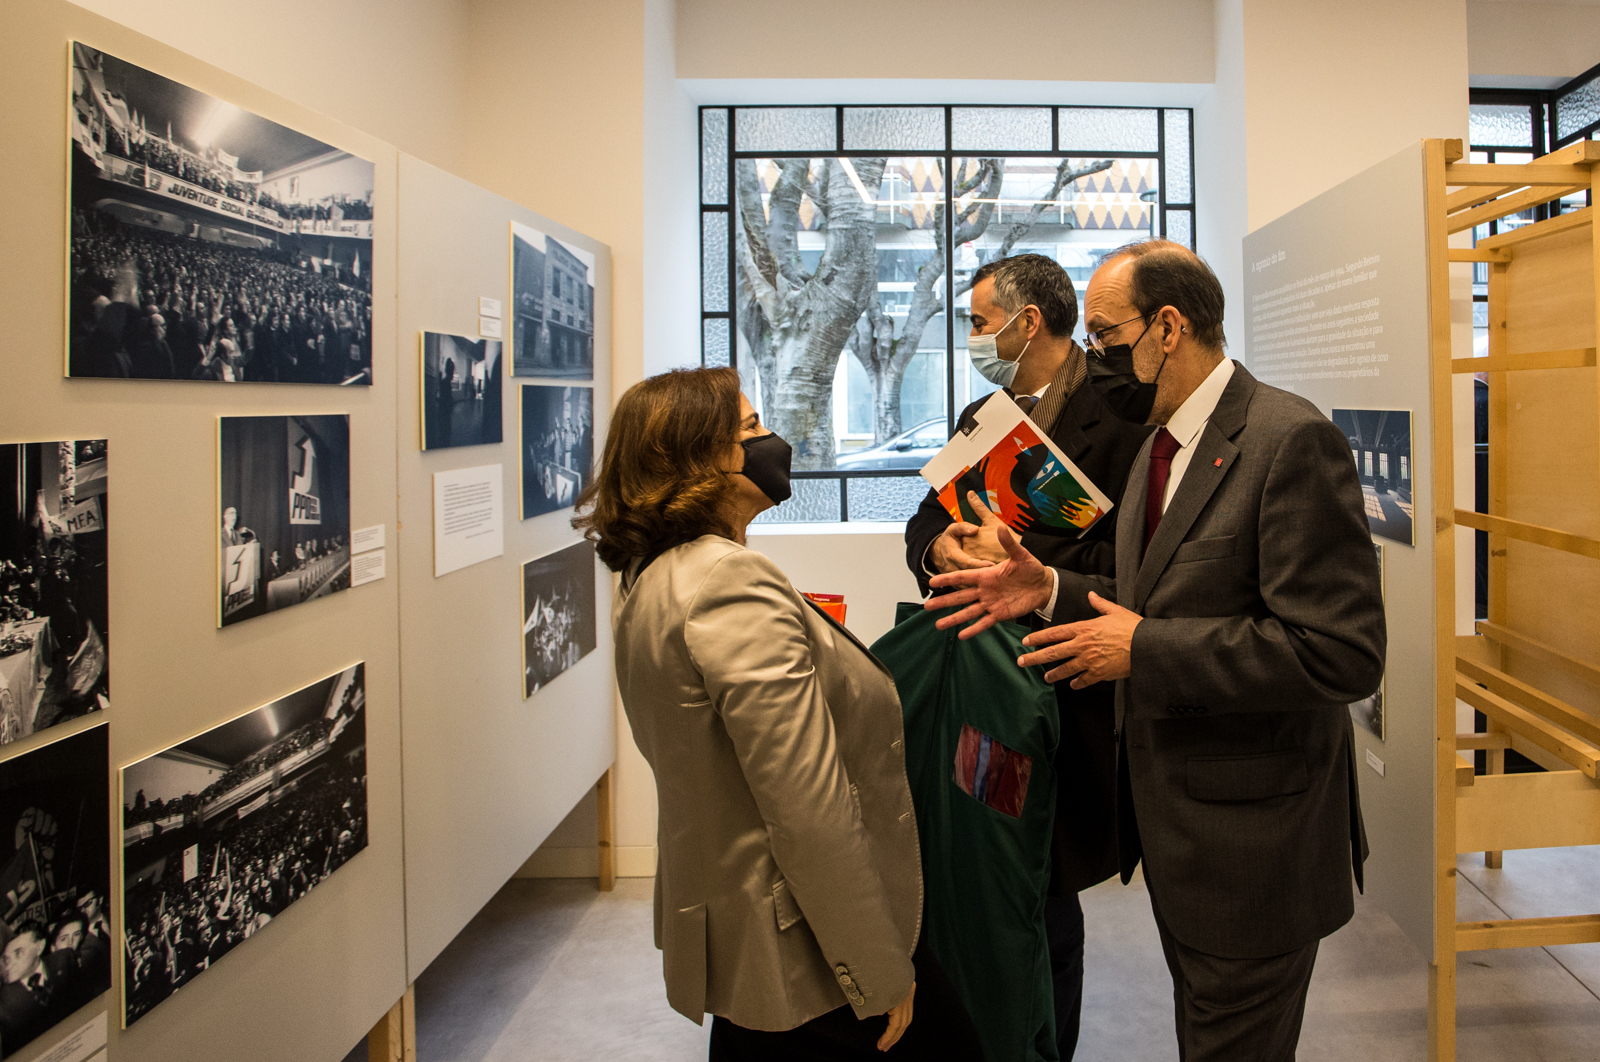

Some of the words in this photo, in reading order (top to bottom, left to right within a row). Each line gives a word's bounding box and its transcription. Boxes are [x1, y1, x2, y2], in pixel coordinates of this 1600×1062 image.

[168, 183, 218, 208] JUVENTUDE
[220, 200, 245, 217] SOCIAL
[1345, 259, 1362, 273] Segundo
[1363, 254, 1380, 266] Belmiro
[1352, 272, 1367, 284] familiar
[1368, 270, 1377, 281] que
[1361, 296, 1379, 309] resposta
[1372, 325, 1383, 336] para
[1356, 354, 1370, 365] agosto
[1377, 354, 1388, 362] 2010
